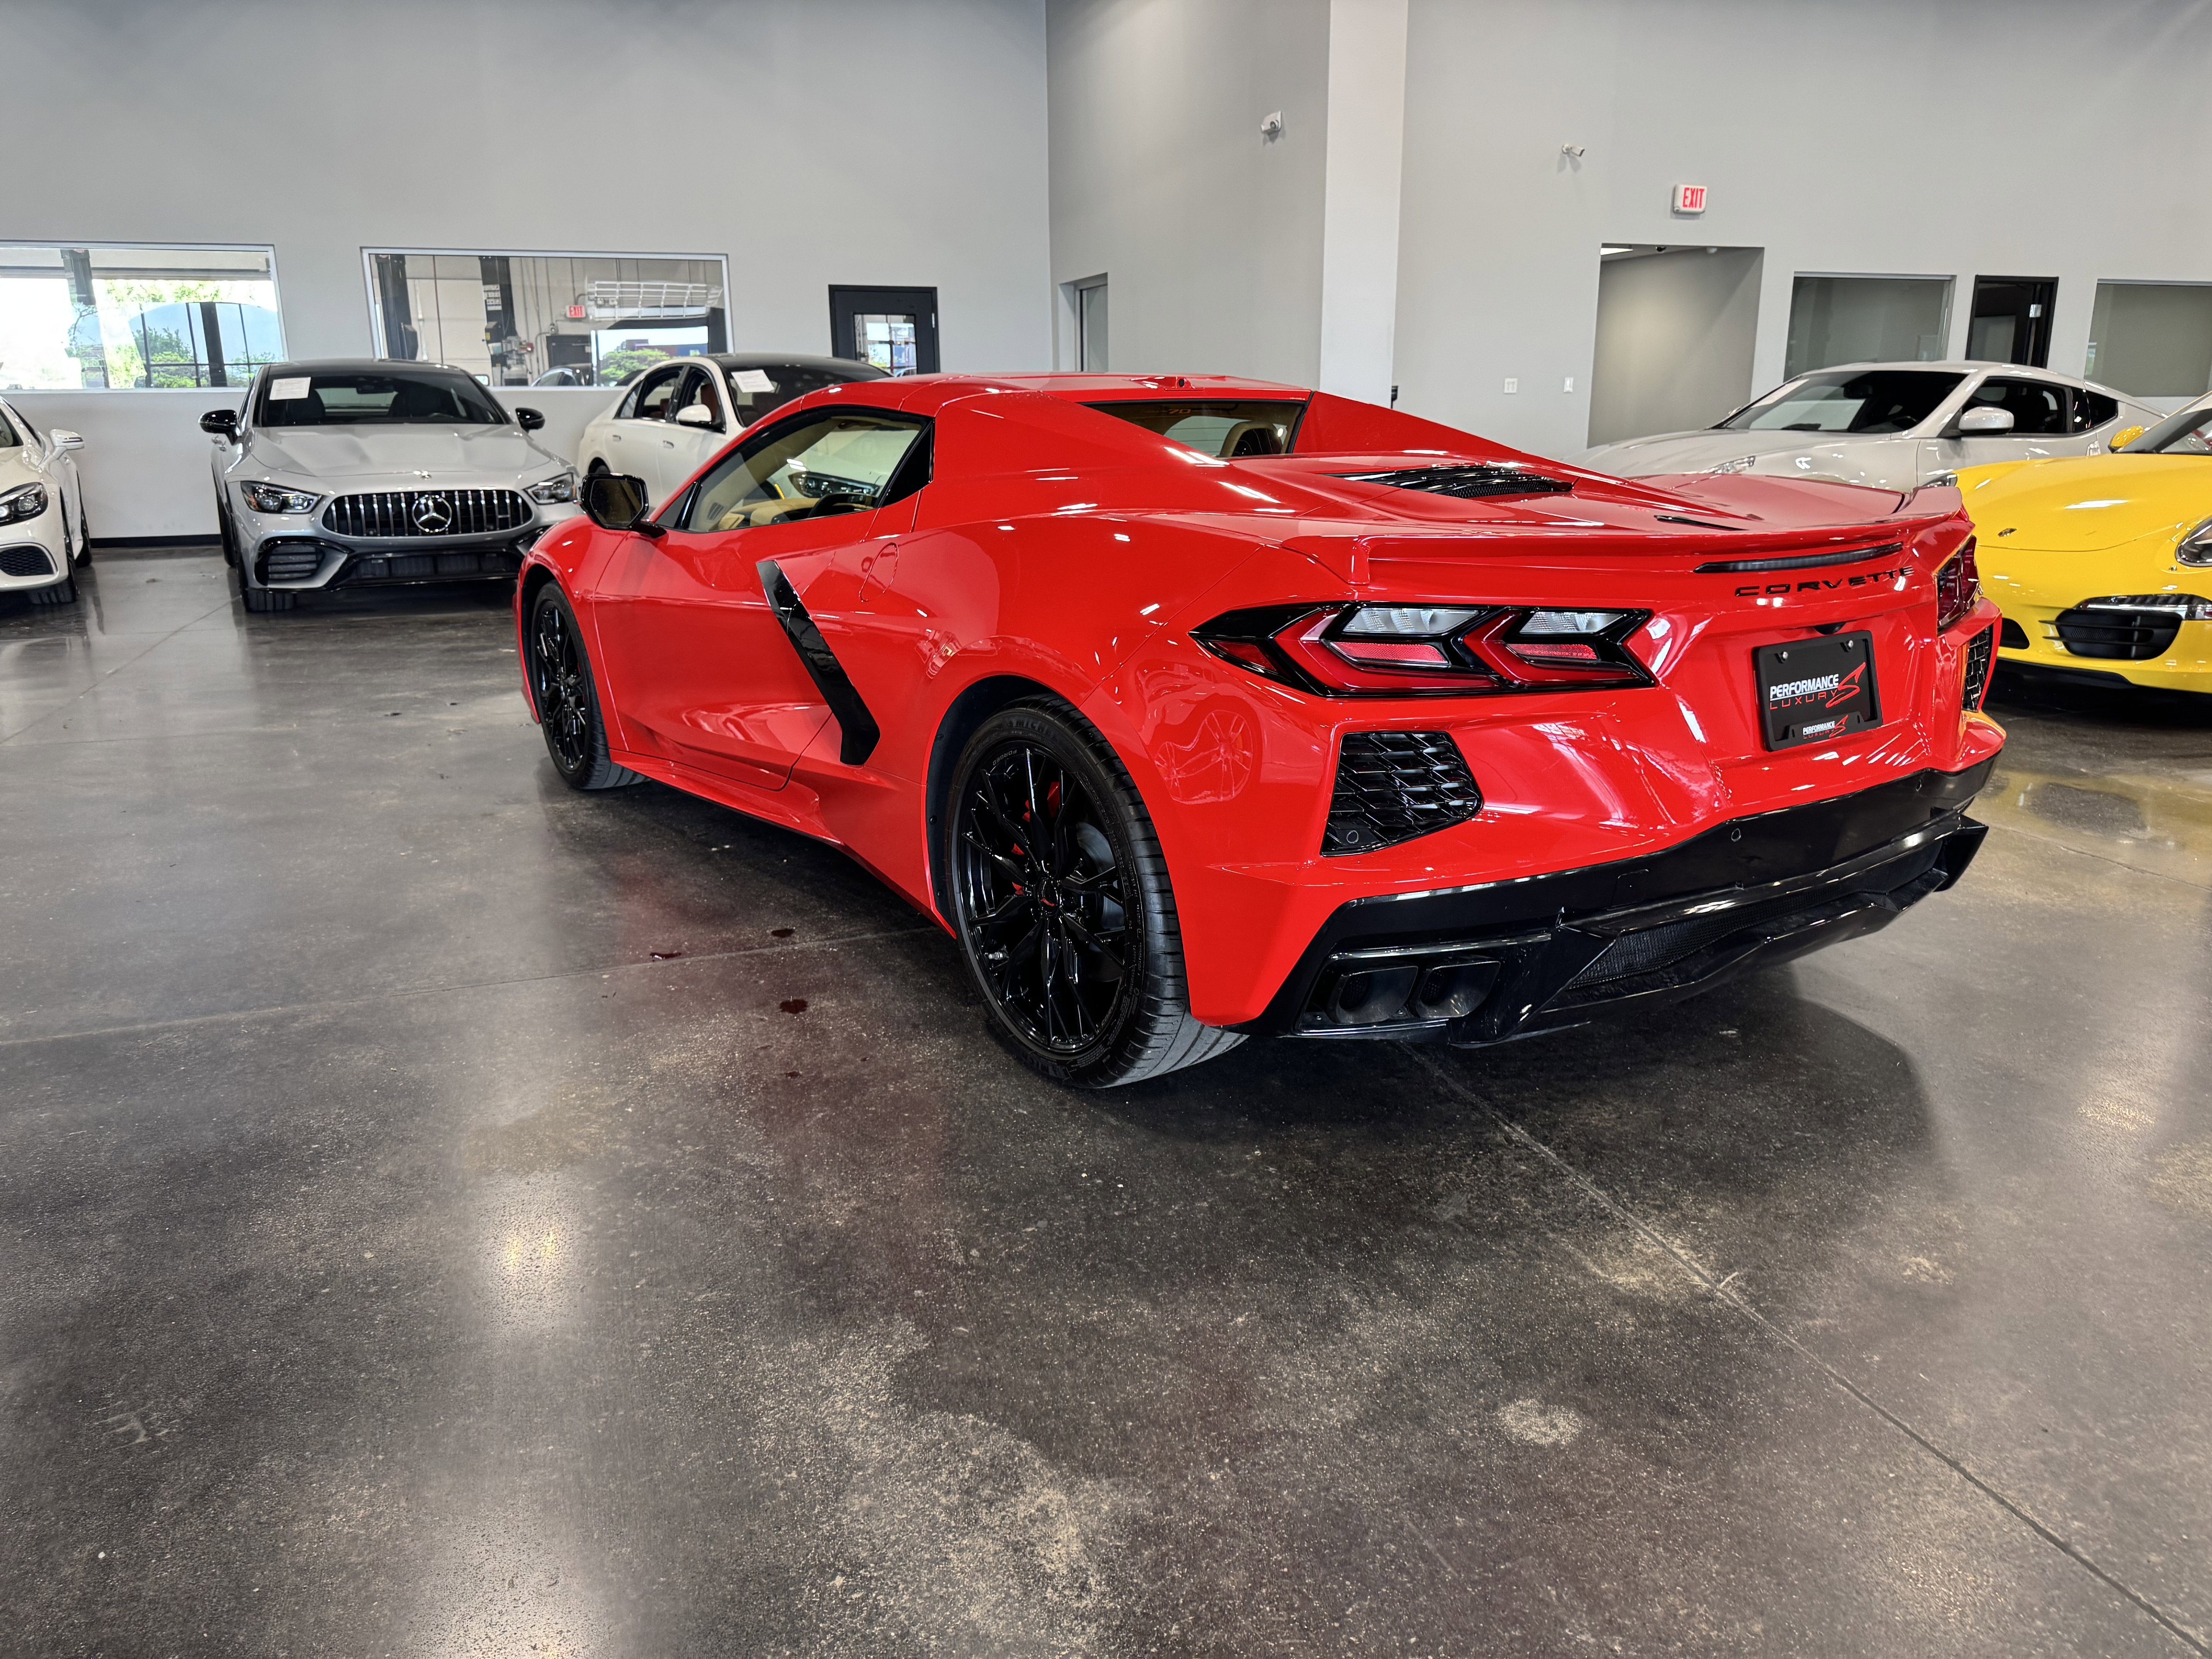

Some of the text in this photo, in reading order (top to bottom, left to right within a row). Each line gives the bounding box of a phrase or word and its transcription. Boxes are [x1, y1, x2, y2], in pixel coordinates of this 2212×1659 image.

[1683, 187, 1705, 209] EXIT
[569, 306, 583, 316] EXIT
[1735, 565, 1914, 597] CORVETTE
[1770, 674, 1839, 699] PERFORMANCE
[1770, 689, 1837, 710] LUXURY
[1803, 721, 1835, 735] PERFORMANCE
[993, 749, 1017, 766] FORGED
